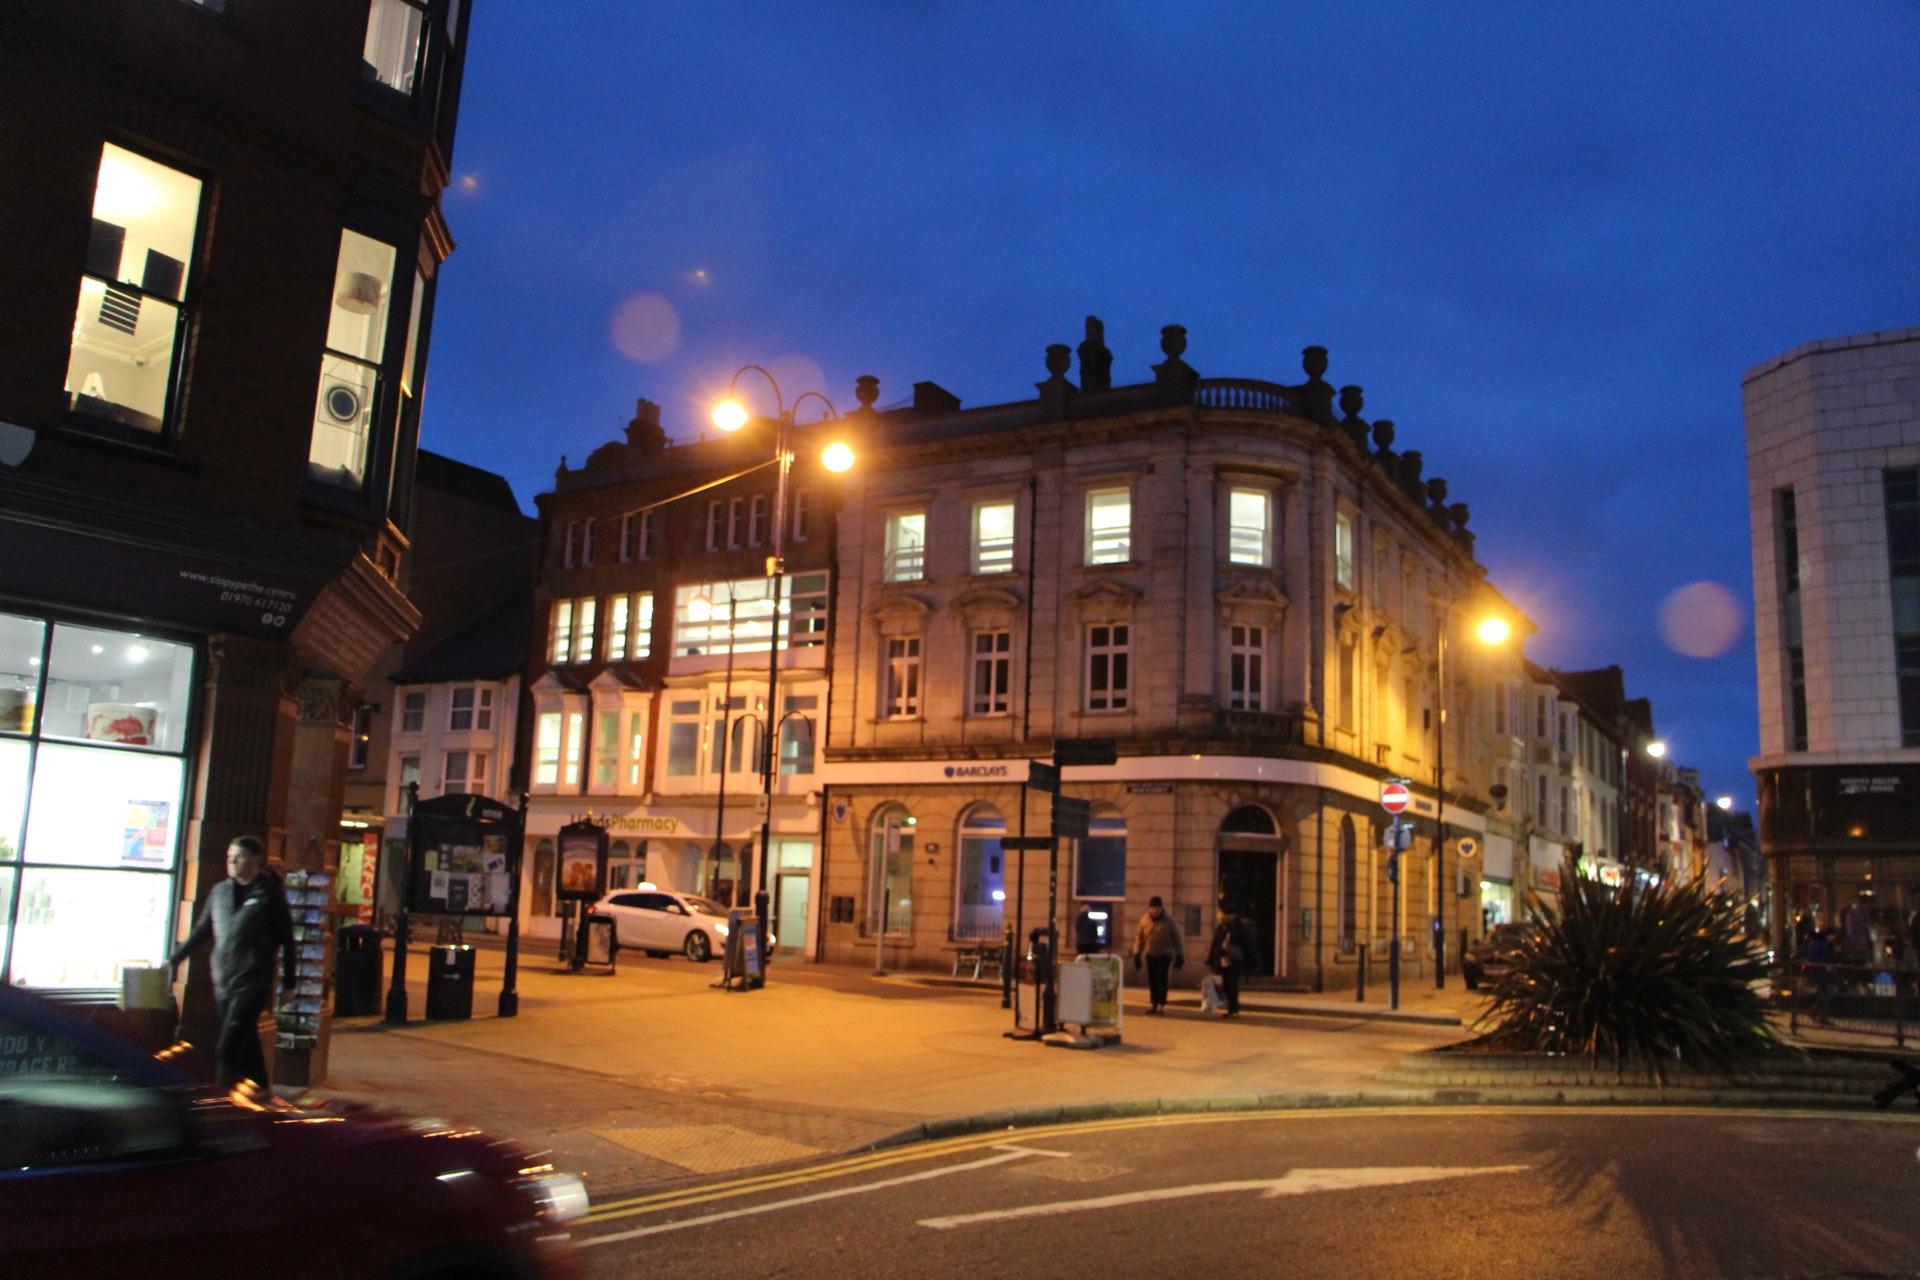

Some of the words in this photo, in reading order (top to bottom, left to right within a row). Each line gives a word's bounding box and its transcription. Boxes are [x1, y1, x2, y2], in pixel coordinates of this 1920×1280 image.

[221, 591, 253, 606] 01970
[254, 598, 292, 613] 617120
[956, 765, 1008, 777] BARCLAYS
[361, 852, 377, 899] KFC
